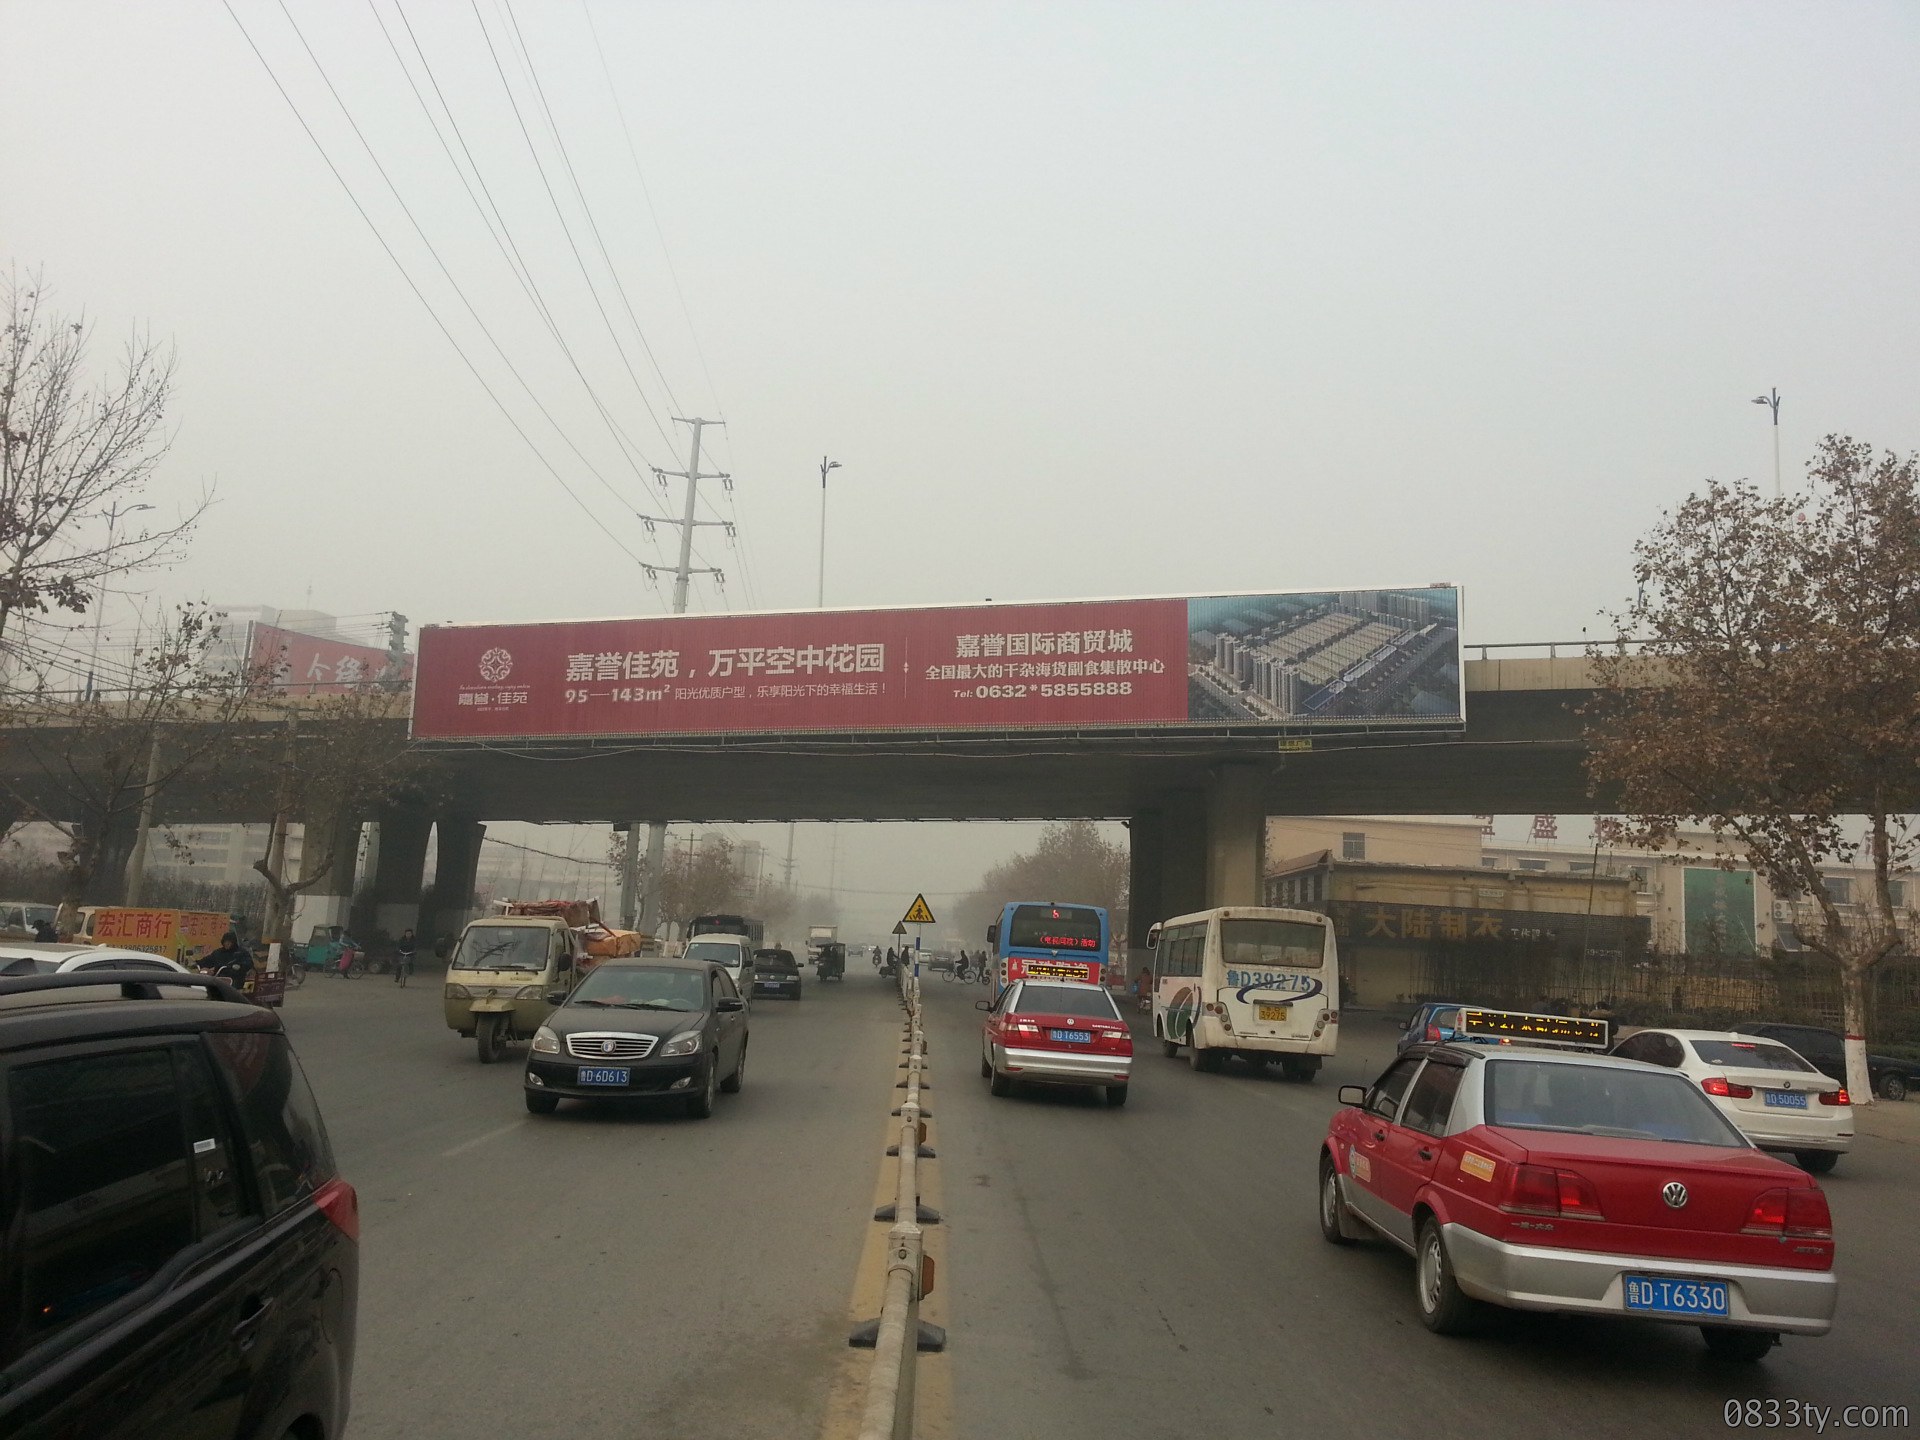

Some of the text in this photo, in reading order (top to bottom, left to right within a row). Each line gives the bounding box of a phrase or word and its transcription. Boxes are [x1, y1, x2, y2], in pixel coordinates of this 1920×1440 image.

[956, 628, 1133, 658] 嘉誉国际商贸城
[925, 658, 1165, 680] 全国最大的干杂海货副食集散中心
[953, 690, 973, 698] Tel:
[97, 911, 172, 939] 宏汇商行
[1260, 1010, 1287, 1021] 39275
